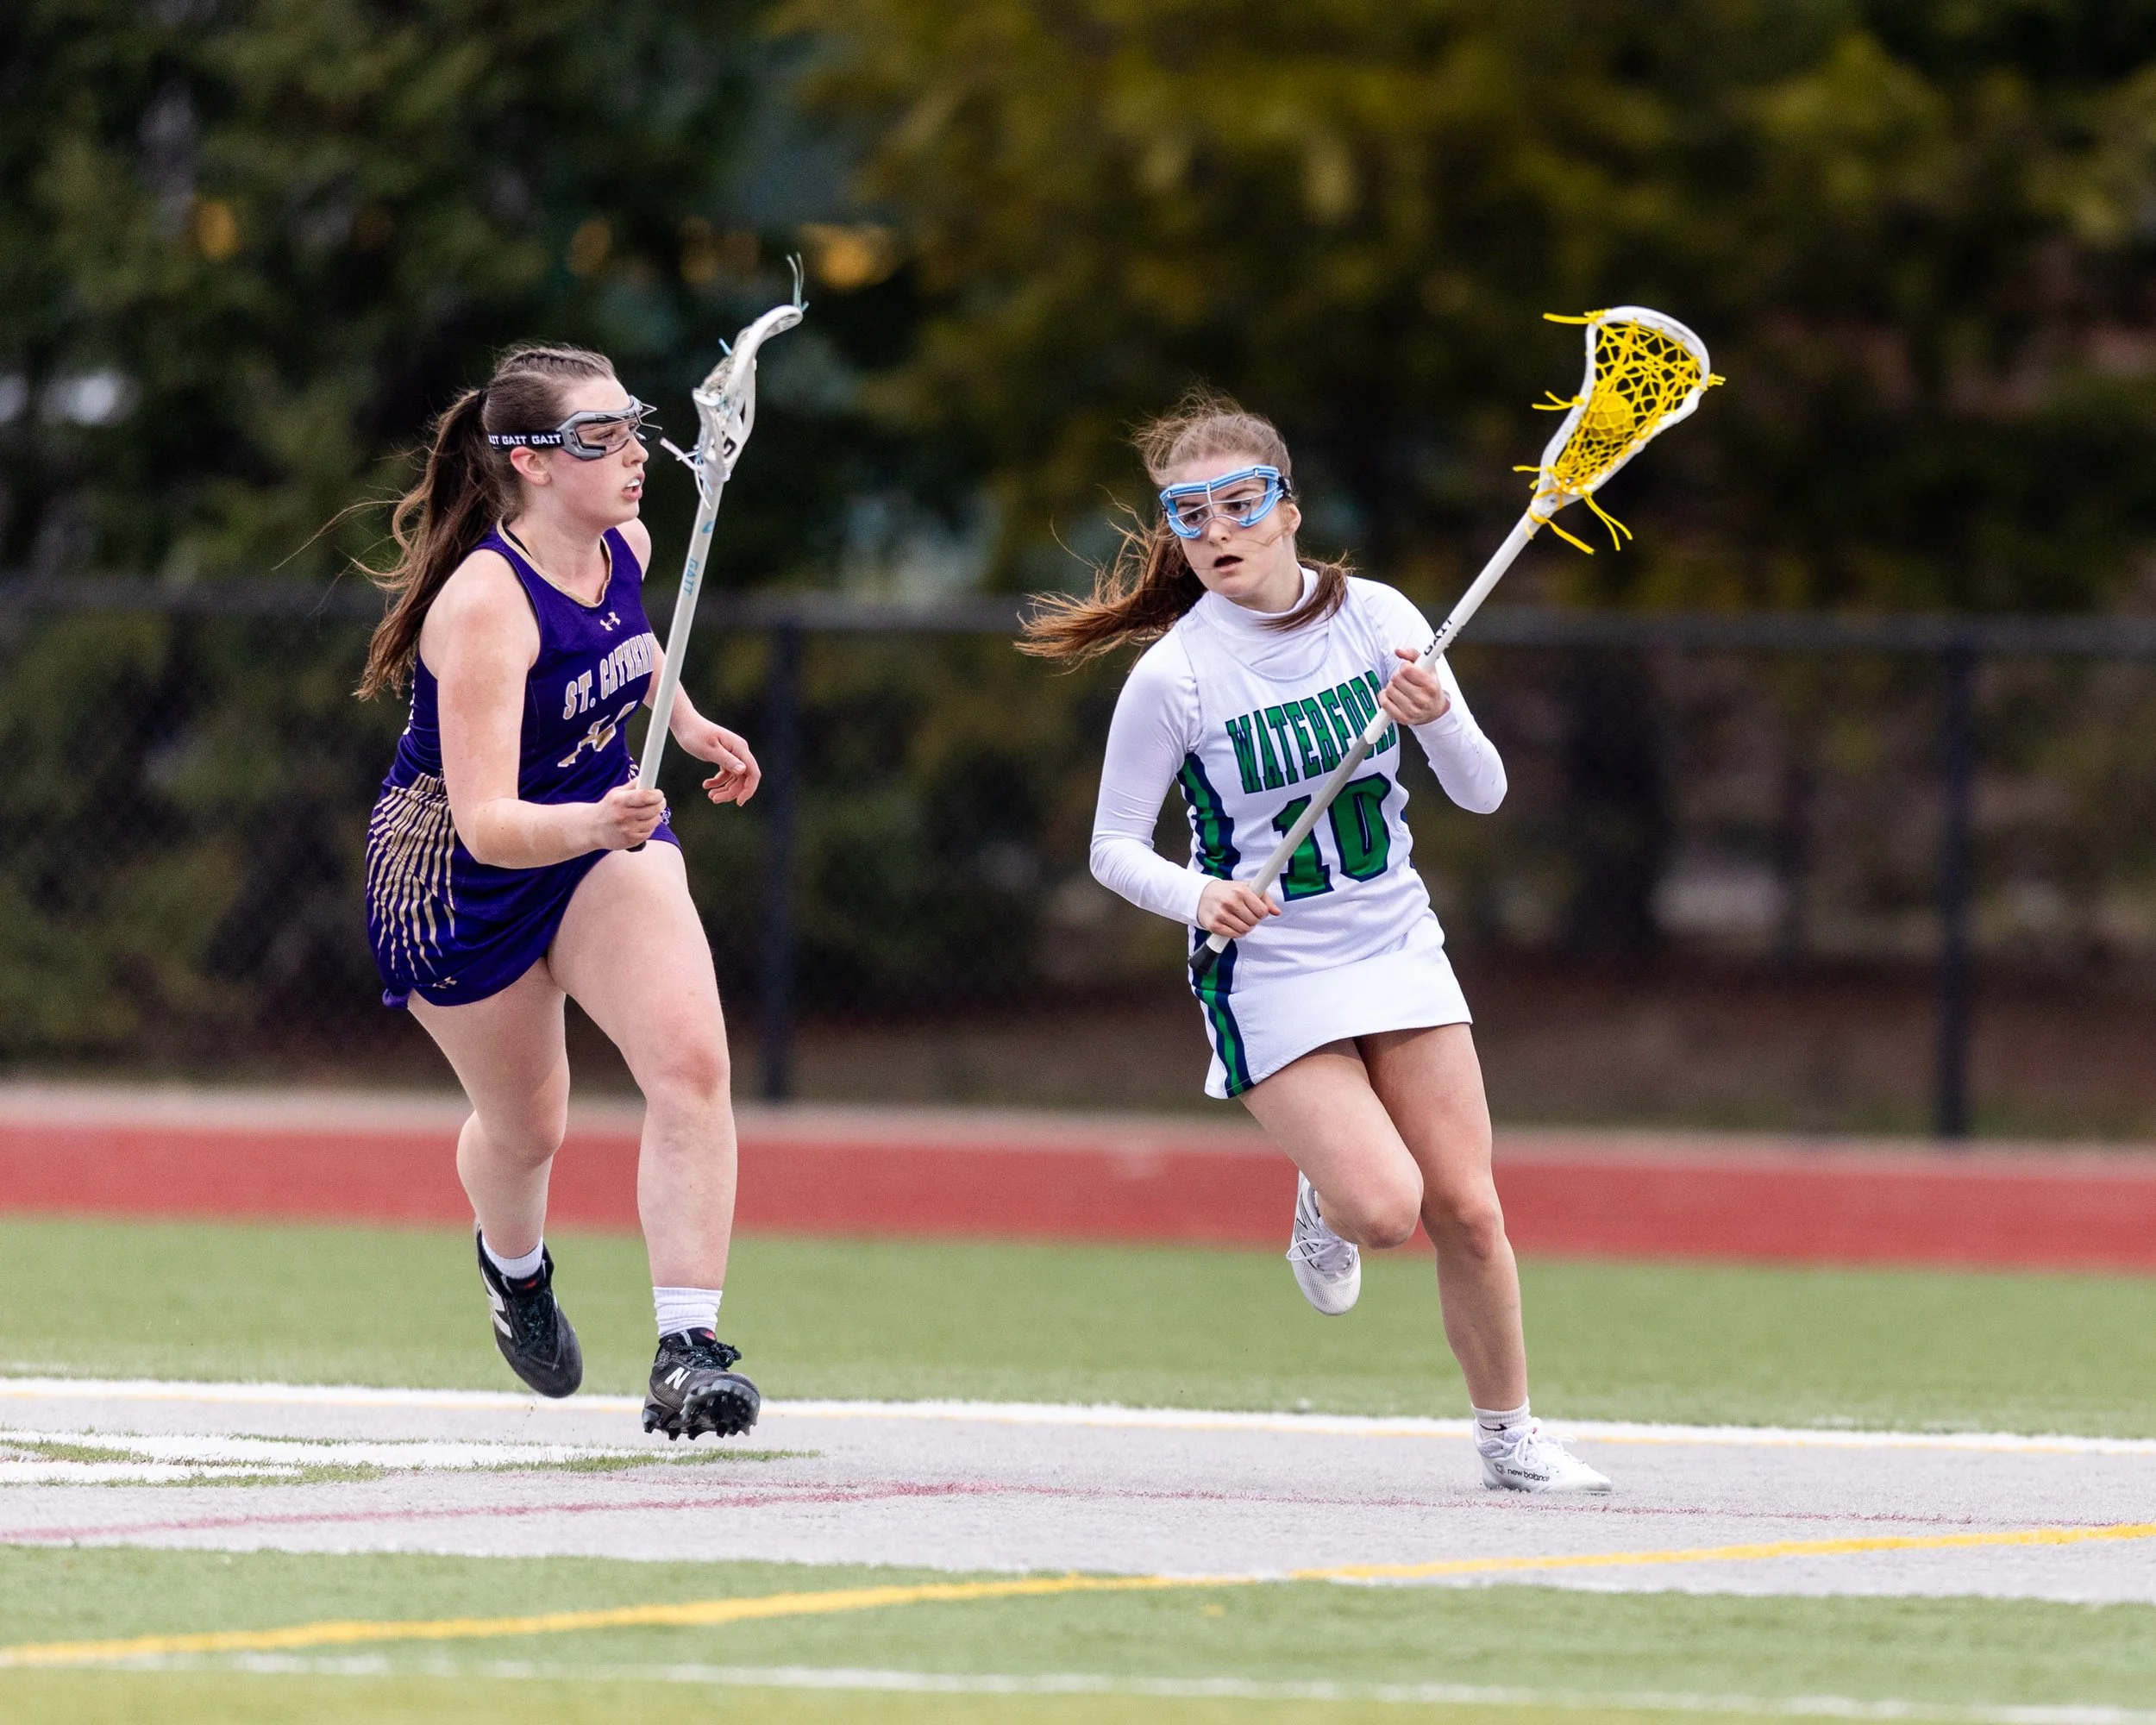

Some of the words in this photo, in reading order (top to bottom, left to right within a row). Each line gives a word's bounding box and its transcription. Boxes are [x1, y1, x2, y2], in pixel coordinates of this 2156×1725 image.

[502, 435, 527, 445] GAIT
[531, 433, 562, 445] GAIT
[562, 668, 597, 720] ST.
[1271, 771, 1392, 902] 10
[663, 1366, 691, 1390] N
[1507, 1468, 1523, 1477] new
[1523, 1470, 1551, 1482] balance
